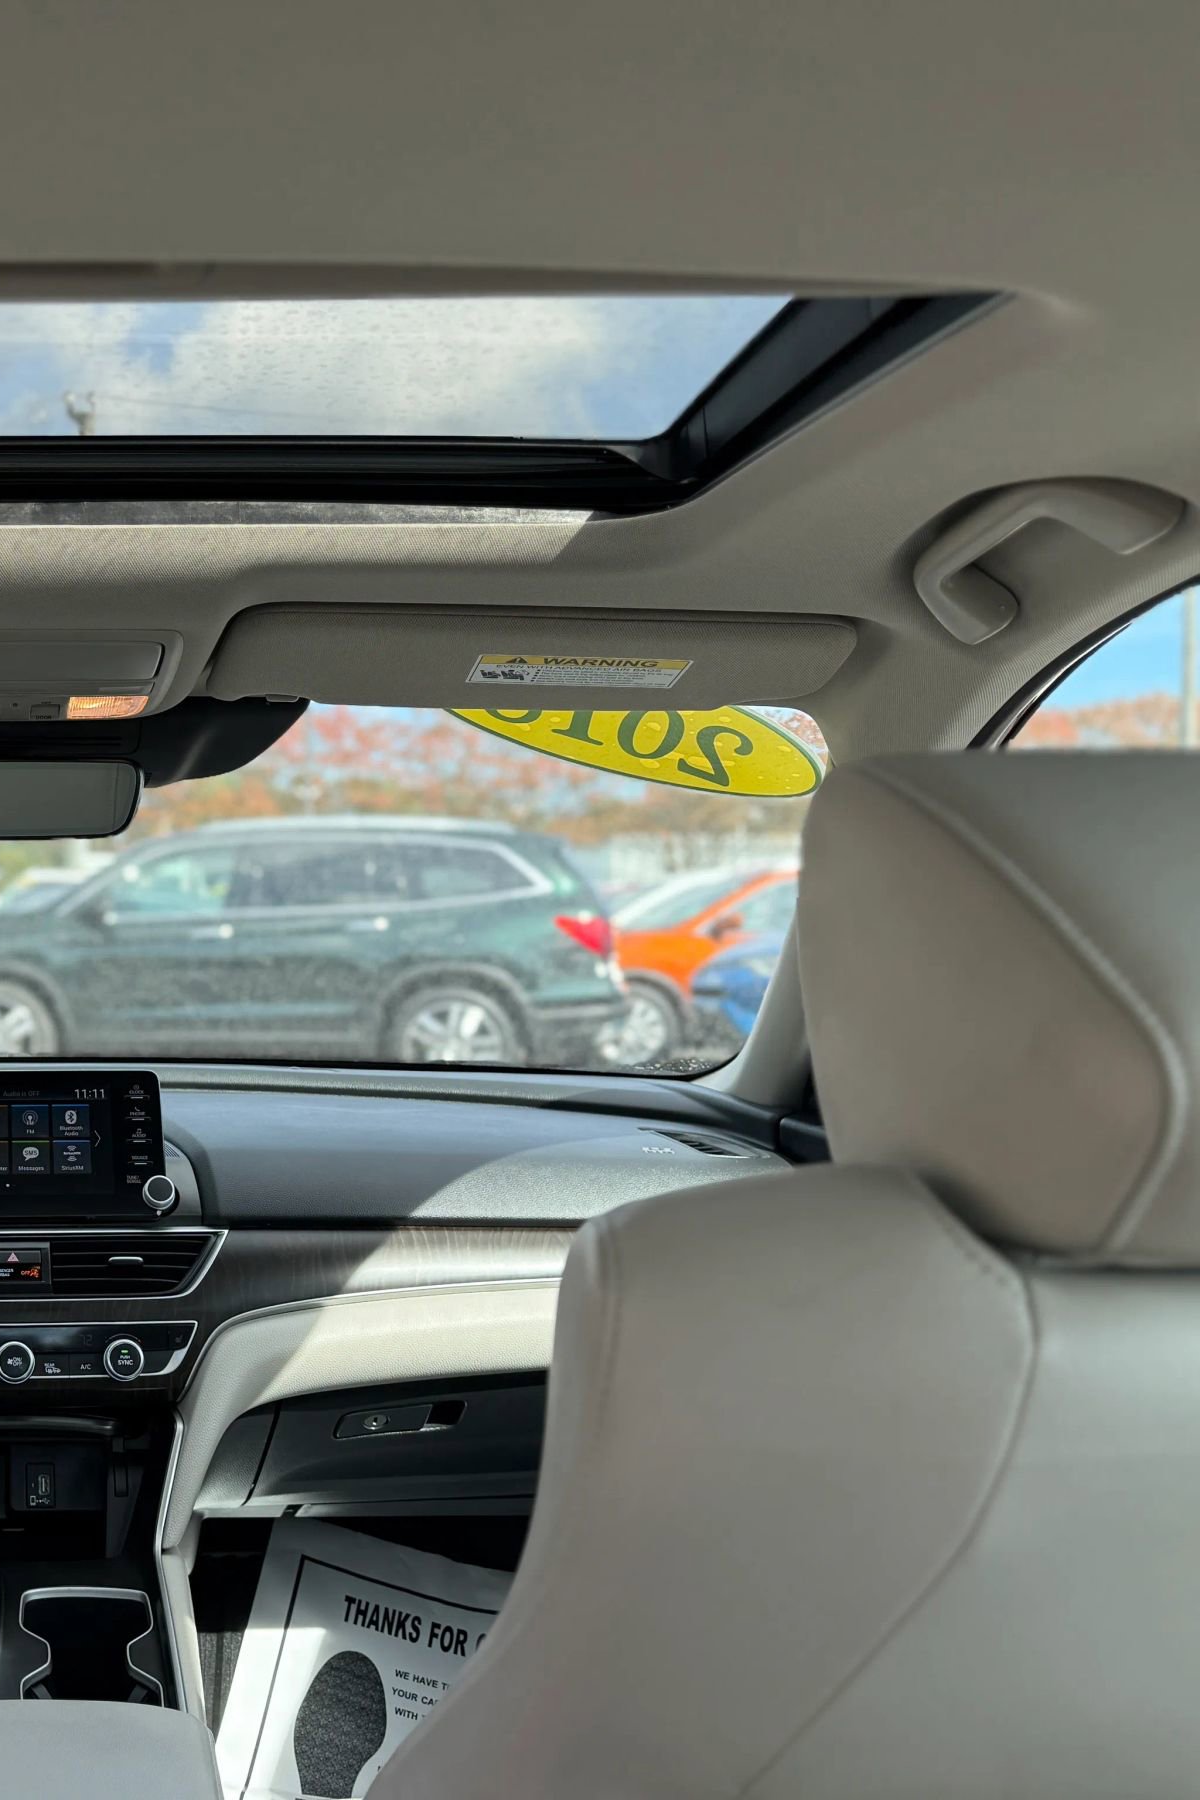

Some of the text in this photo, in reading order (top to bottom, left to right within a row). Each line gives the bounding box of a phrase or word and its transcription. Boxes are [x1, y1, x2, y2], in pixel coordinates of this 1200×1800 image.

[543, 657, 658, 668] WARNING
[74, 1088, 105, 1099] 11:11
[344, 1594, 422, 1643] THANKS
[428, 1621, 468, 1657] FOR
[395, 1669, 410, 1680] WE
[412, 1674, 439, 1688] HAVE
[392, 1687, 418, 1702] YOUR
[394, 1707, 418, 1721] WITH
